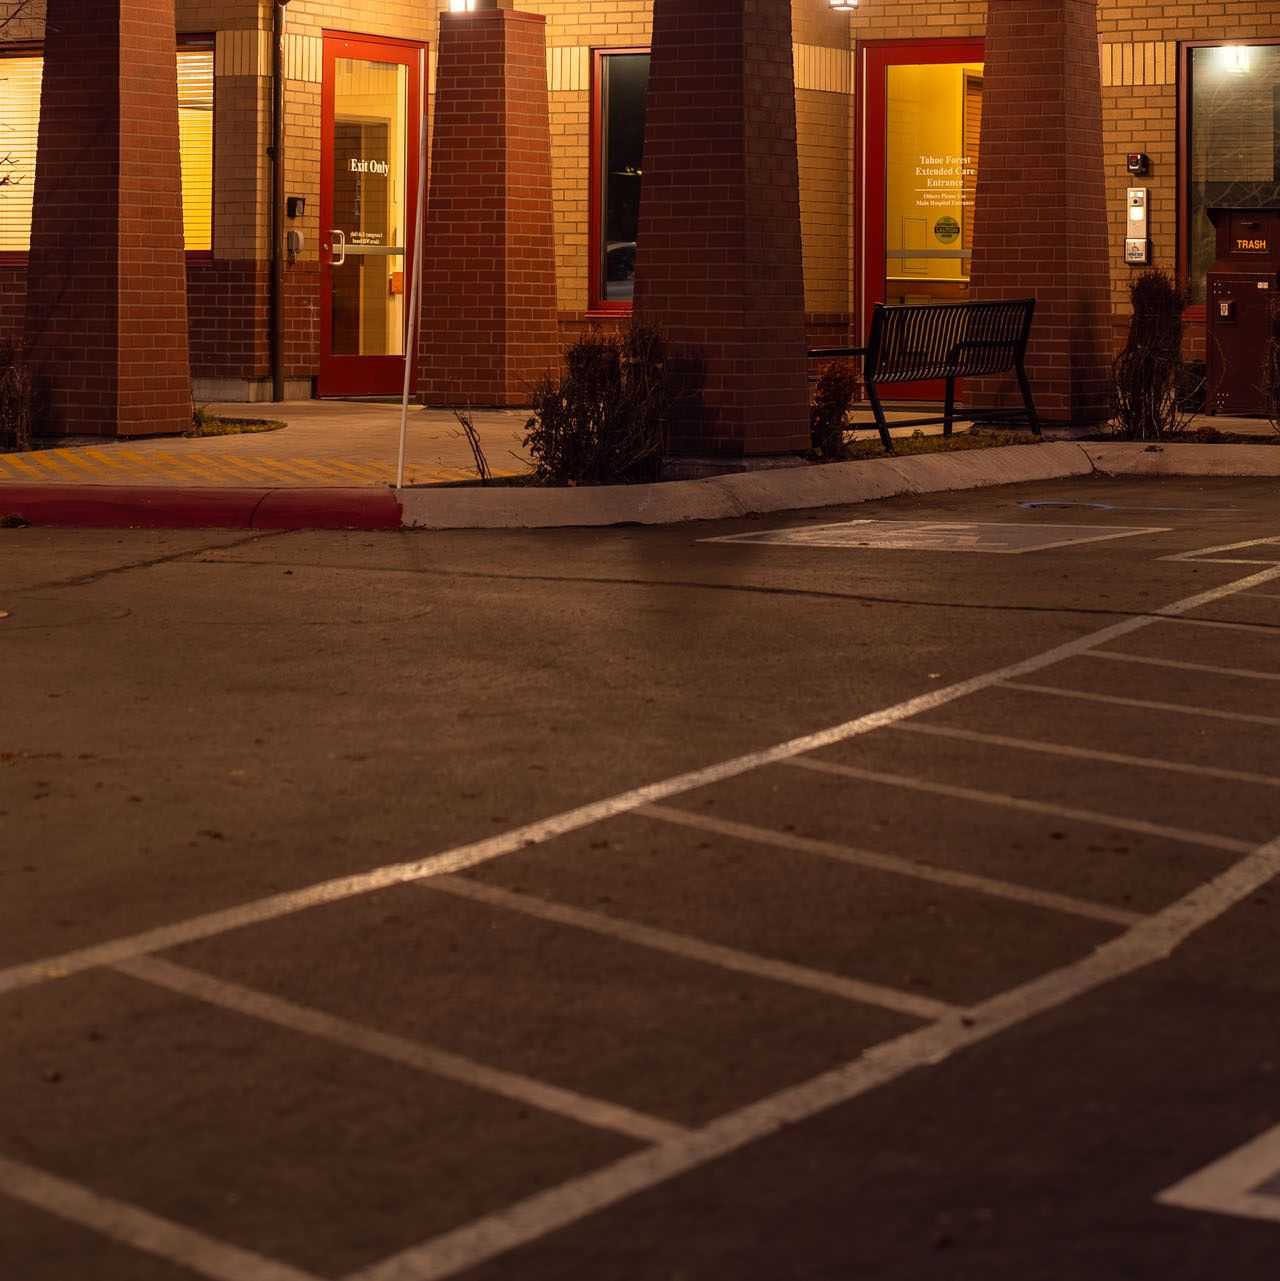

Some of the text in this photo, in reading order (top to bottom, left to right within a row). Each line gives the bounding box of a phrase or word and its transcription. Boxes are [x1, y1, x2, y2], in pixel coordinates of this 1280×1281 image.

[920, 156, 943, 164] Tahoe
[351, 159, 389, 176] Exit Only
[916, 167, 976, 176] Extended Care
[927, 179, 964, 187] Entrance
[1237, 240, 1266, 249] TRASH
